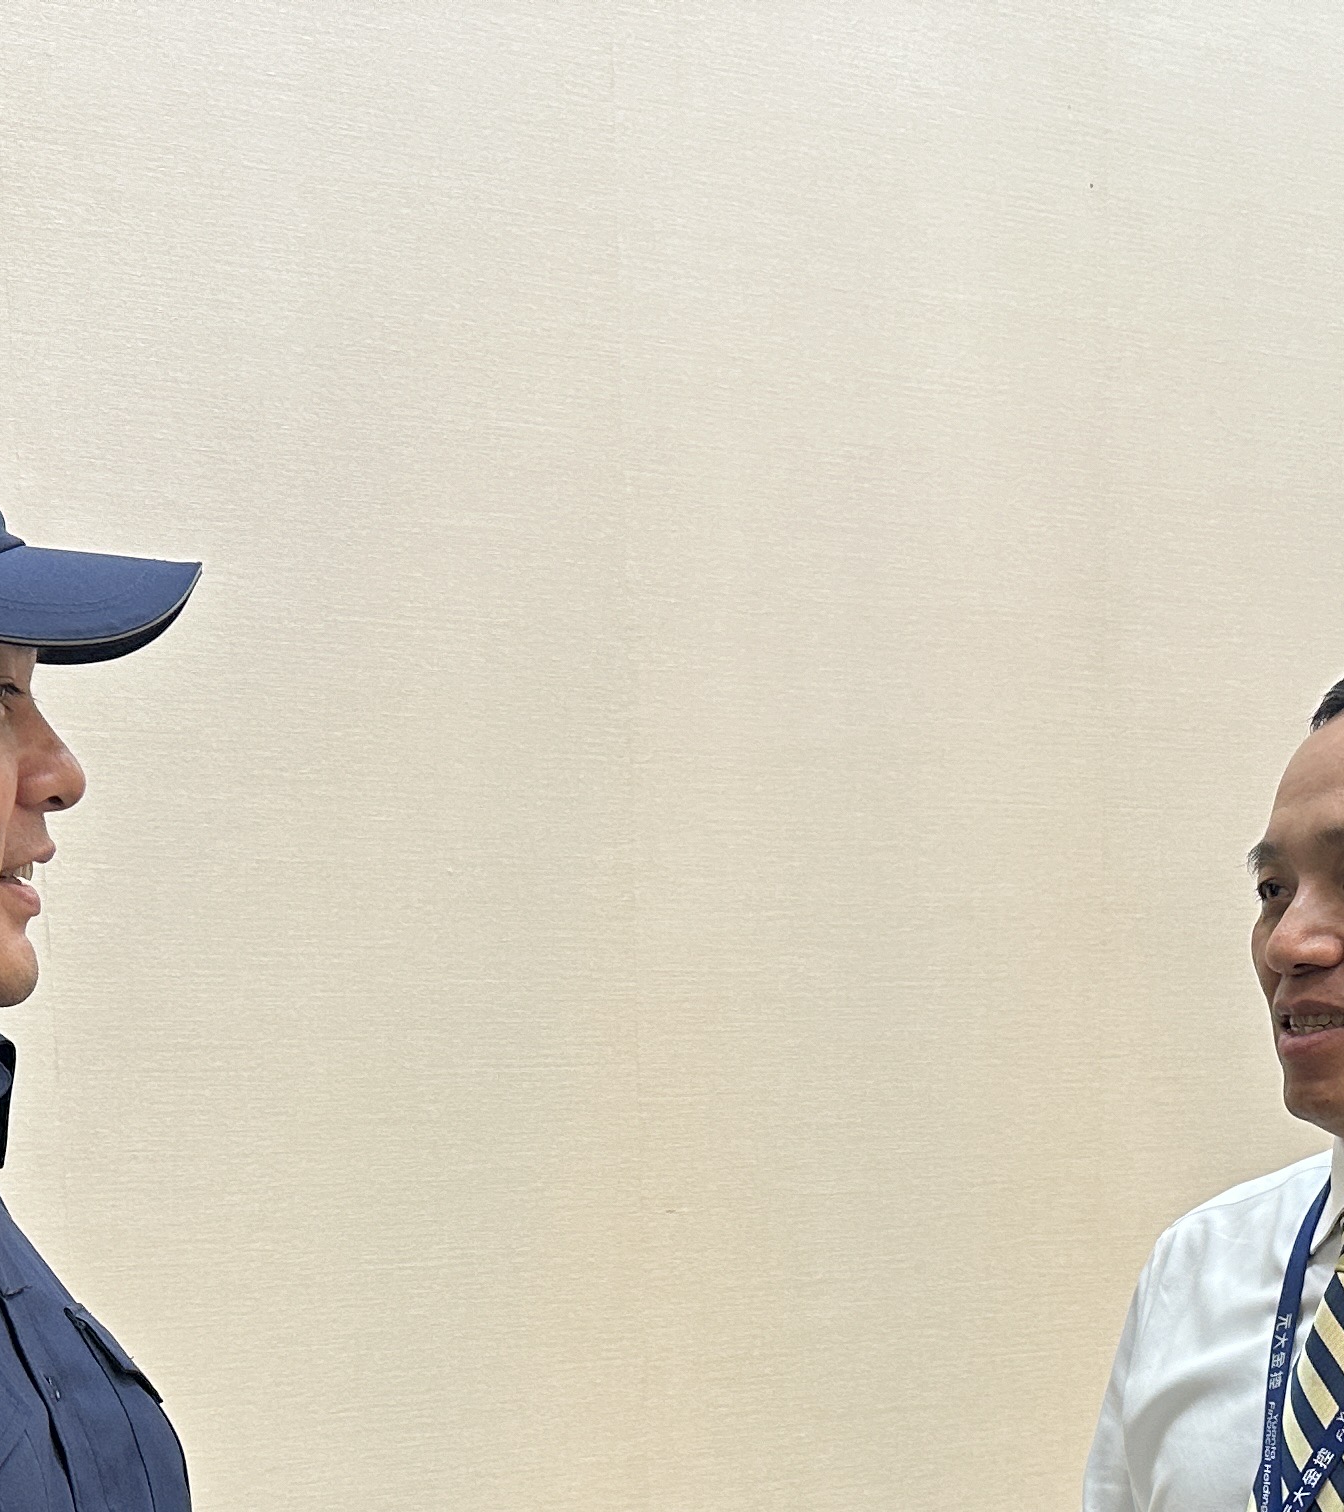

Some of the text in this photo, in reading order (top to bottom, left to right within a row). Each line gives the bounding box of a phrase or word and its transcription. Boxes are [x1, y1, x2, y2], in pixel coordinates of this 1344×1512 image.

[1269, 1313, 1292, 1390] 元大金控
[1264, 1401, 1276, 1461] Financial
[1270, 1413, 1279, 1460] Yuanta
